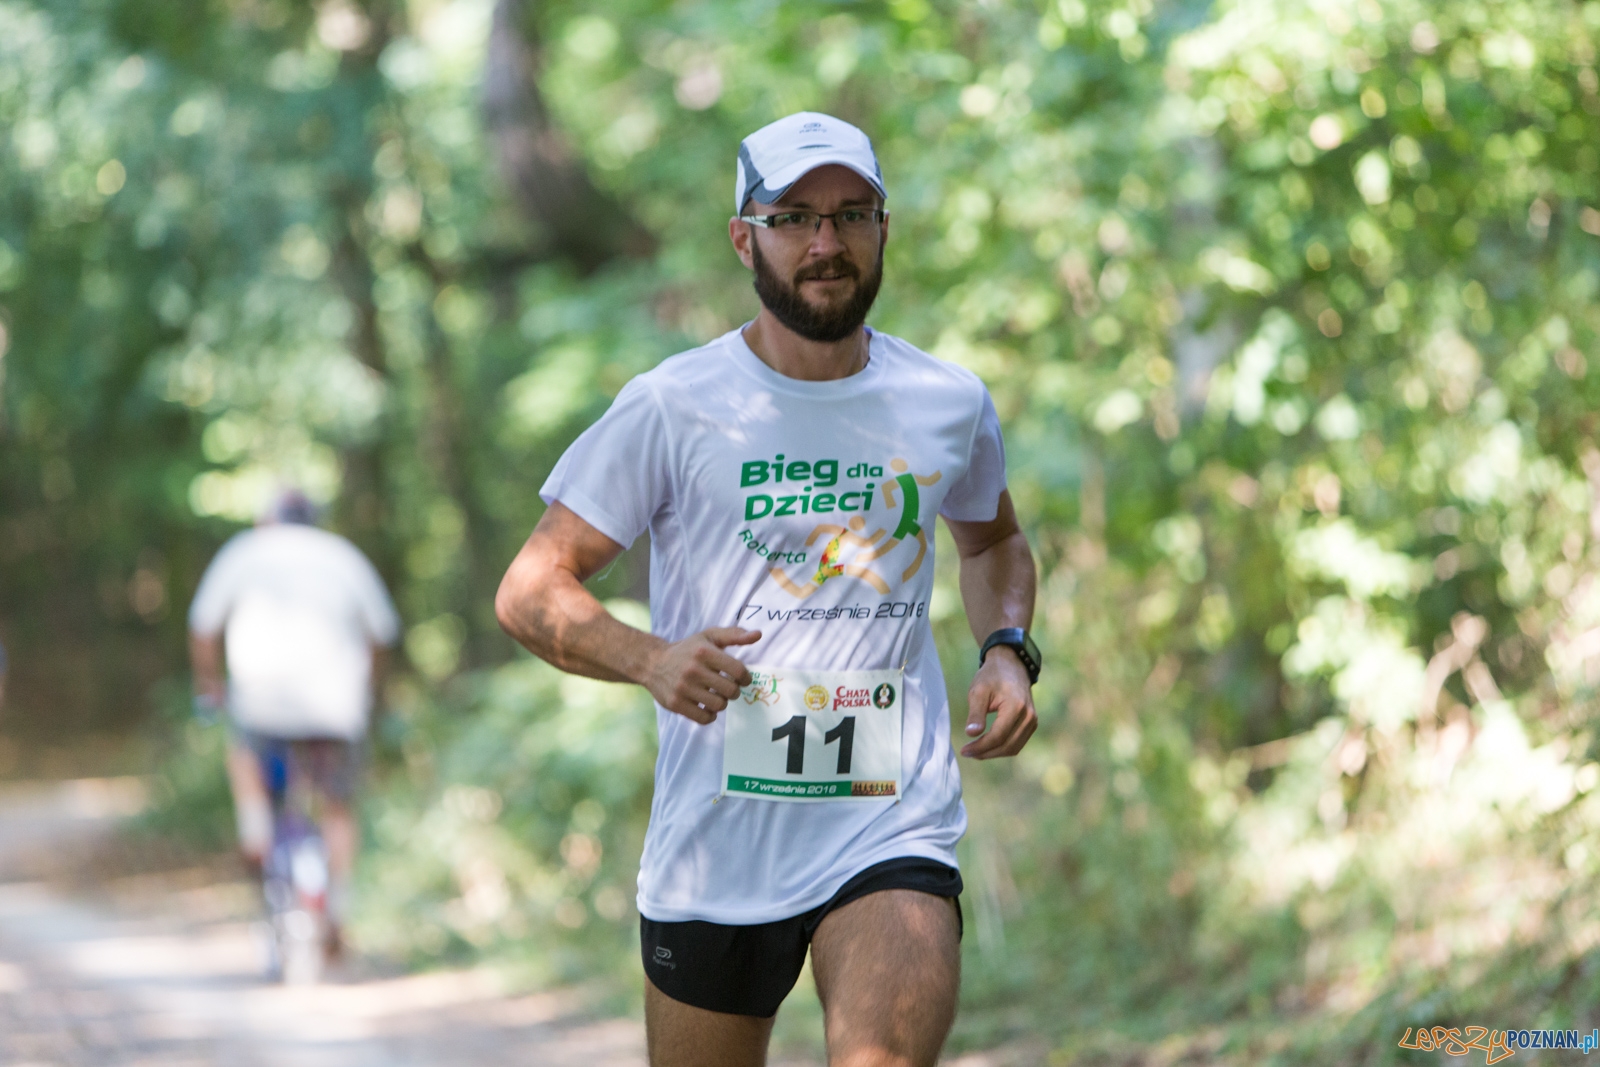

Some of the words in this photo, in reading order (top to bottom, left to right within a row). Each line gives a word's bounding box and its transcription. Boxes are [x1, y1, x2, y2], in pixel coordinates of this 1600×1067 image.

[740, 454, 839, 488] Bieg
[846, 463, 883, 479] dla
[744, 483, 875, 521] Dzieci
[738, 528, 806, 564] Roberta
[736, 604, 763, 620] 17
[767, 603, 871, 621] września
[875, 601, 925, 618] 2016
[832, 698, 871, 711] POLSKA
[835, 686, 870, 699] CHATA
[772, 715, 856, 775] 11
[743, 780, 760, 790] 17
[807, 784, 837, 795] 2016
